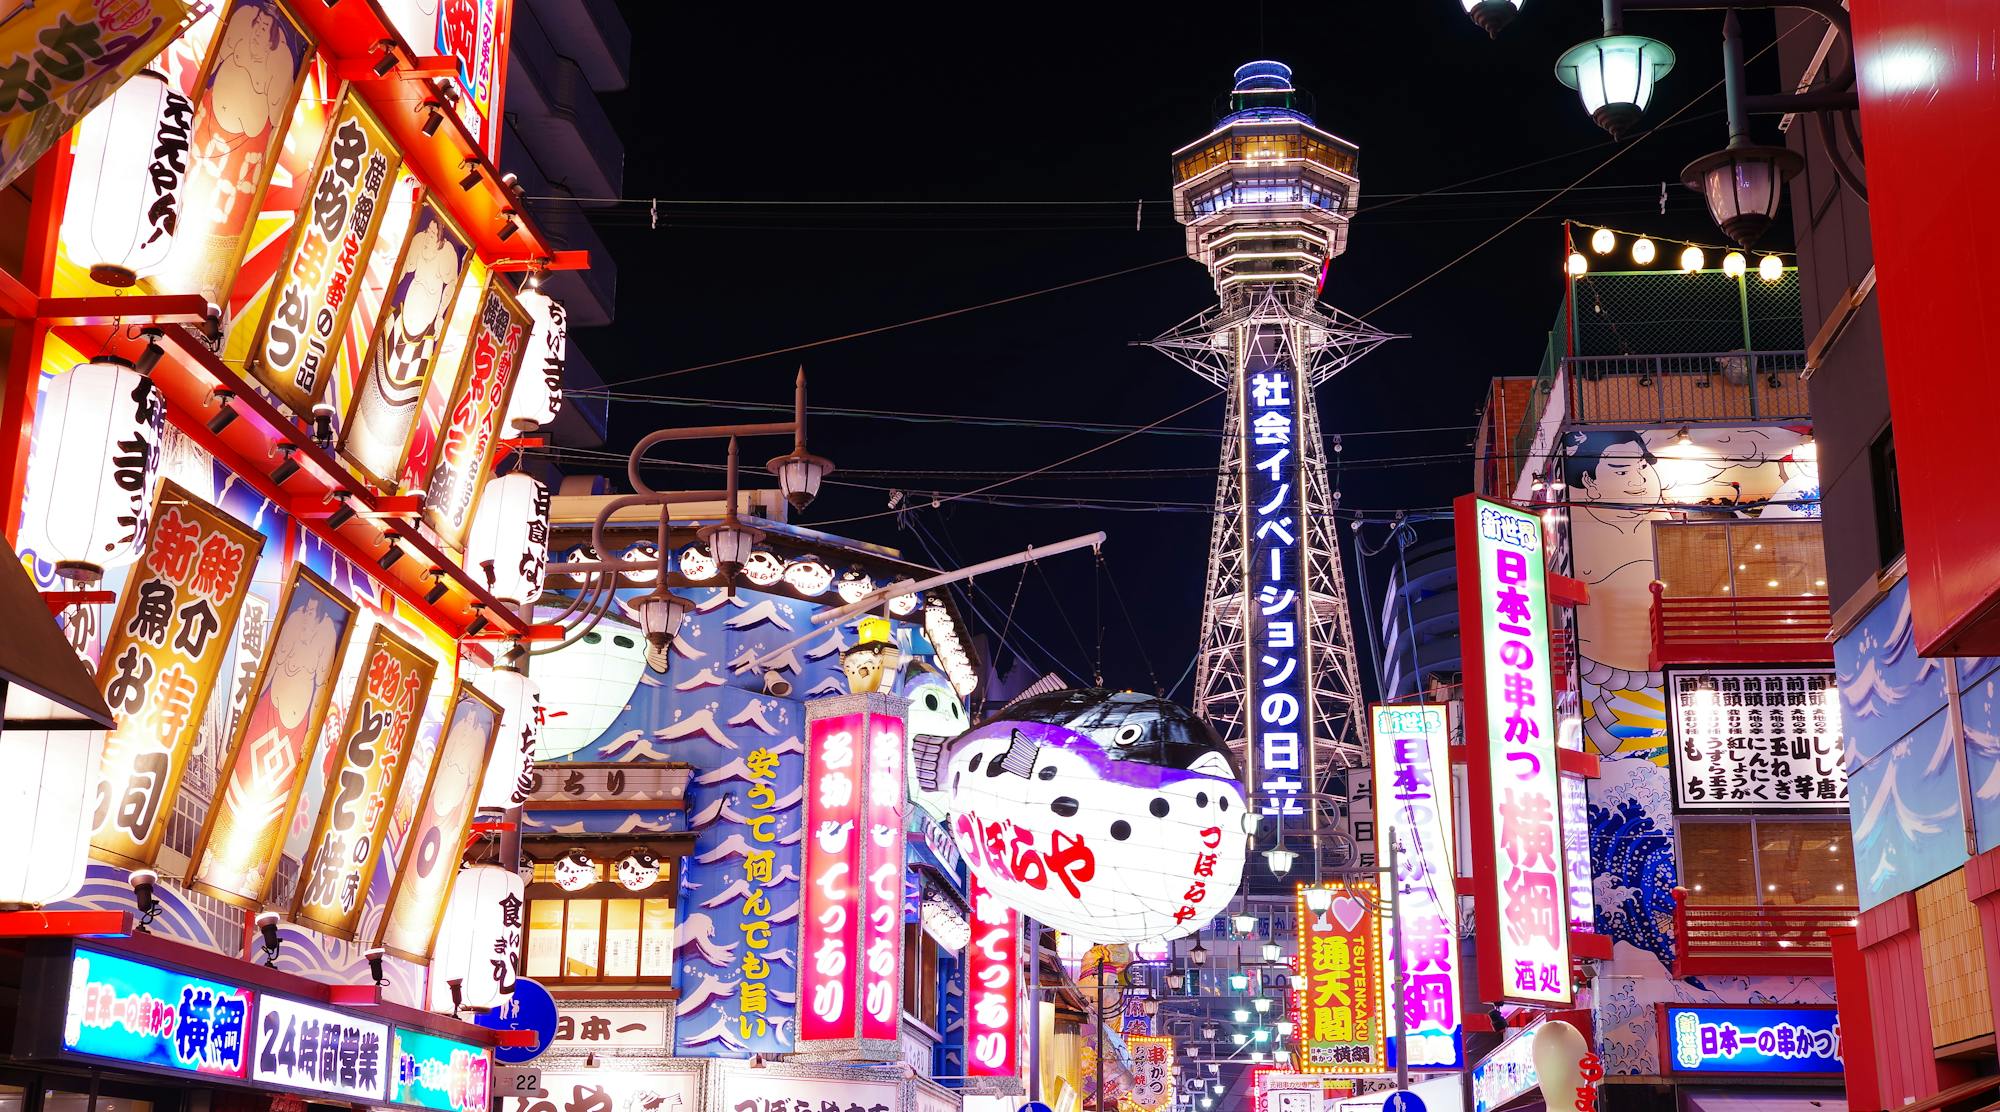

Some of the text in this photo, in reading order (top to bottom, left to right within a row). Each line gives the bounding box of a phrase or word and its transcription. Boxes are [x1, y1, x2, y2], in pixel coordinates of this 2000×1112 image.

[268, 120, 367, 368] 名物串かつ
[297, 151, 387, 393] 横綱定番の一品
[1482, 507, 1537, 549] 新世界
[1252, 373, 1303, 815] 社会イノベーションの日立
[1496, 549, 1541, 780] 日本一の串かつ
[341, 671, 421, 913] 大阪下町の味
[1684, 737, 1706, 800] もち
[1706, 737, 1728, 800] うずら玉子
[1727, 736, 1750, 800] 紅しょうが
[1748, 737, 1770, 800] にんにく
[1770, 736, 1792, 800] 玉ねぎ
[1791, 736, 1815, 800] 山芋
[1813, 736, 1837, 800] しし唐
[738, 747, 781, 1040] 安うて何んでも旨い
[1499, 787, 1561, 951] 横綱
[813, 863, 849, 1023] てっちり
[866, 863, 898, 1023] てっちり
[1312, 935, 1353, 1042] 通天閣
[1352, 935, 1369, 1042] TSUTENKAKU
[1514, 960, 1561, 994] 酒処
[85, 986, 174, 1036] 日本一の串かつ
[176, 988, 246, 1068] 横綱
[260, 1009, 379, 1091] 24時間営業
[558, 1014, 647, 1042] 日本一
[1333, 1045, 1370, 1064] 横綱
[1701, 1026, 1832, 1056] 日本一の串かつ
[516, 1073, 537, 1090] 22
[1147, 1045, 1166, 1094] 串かつ
